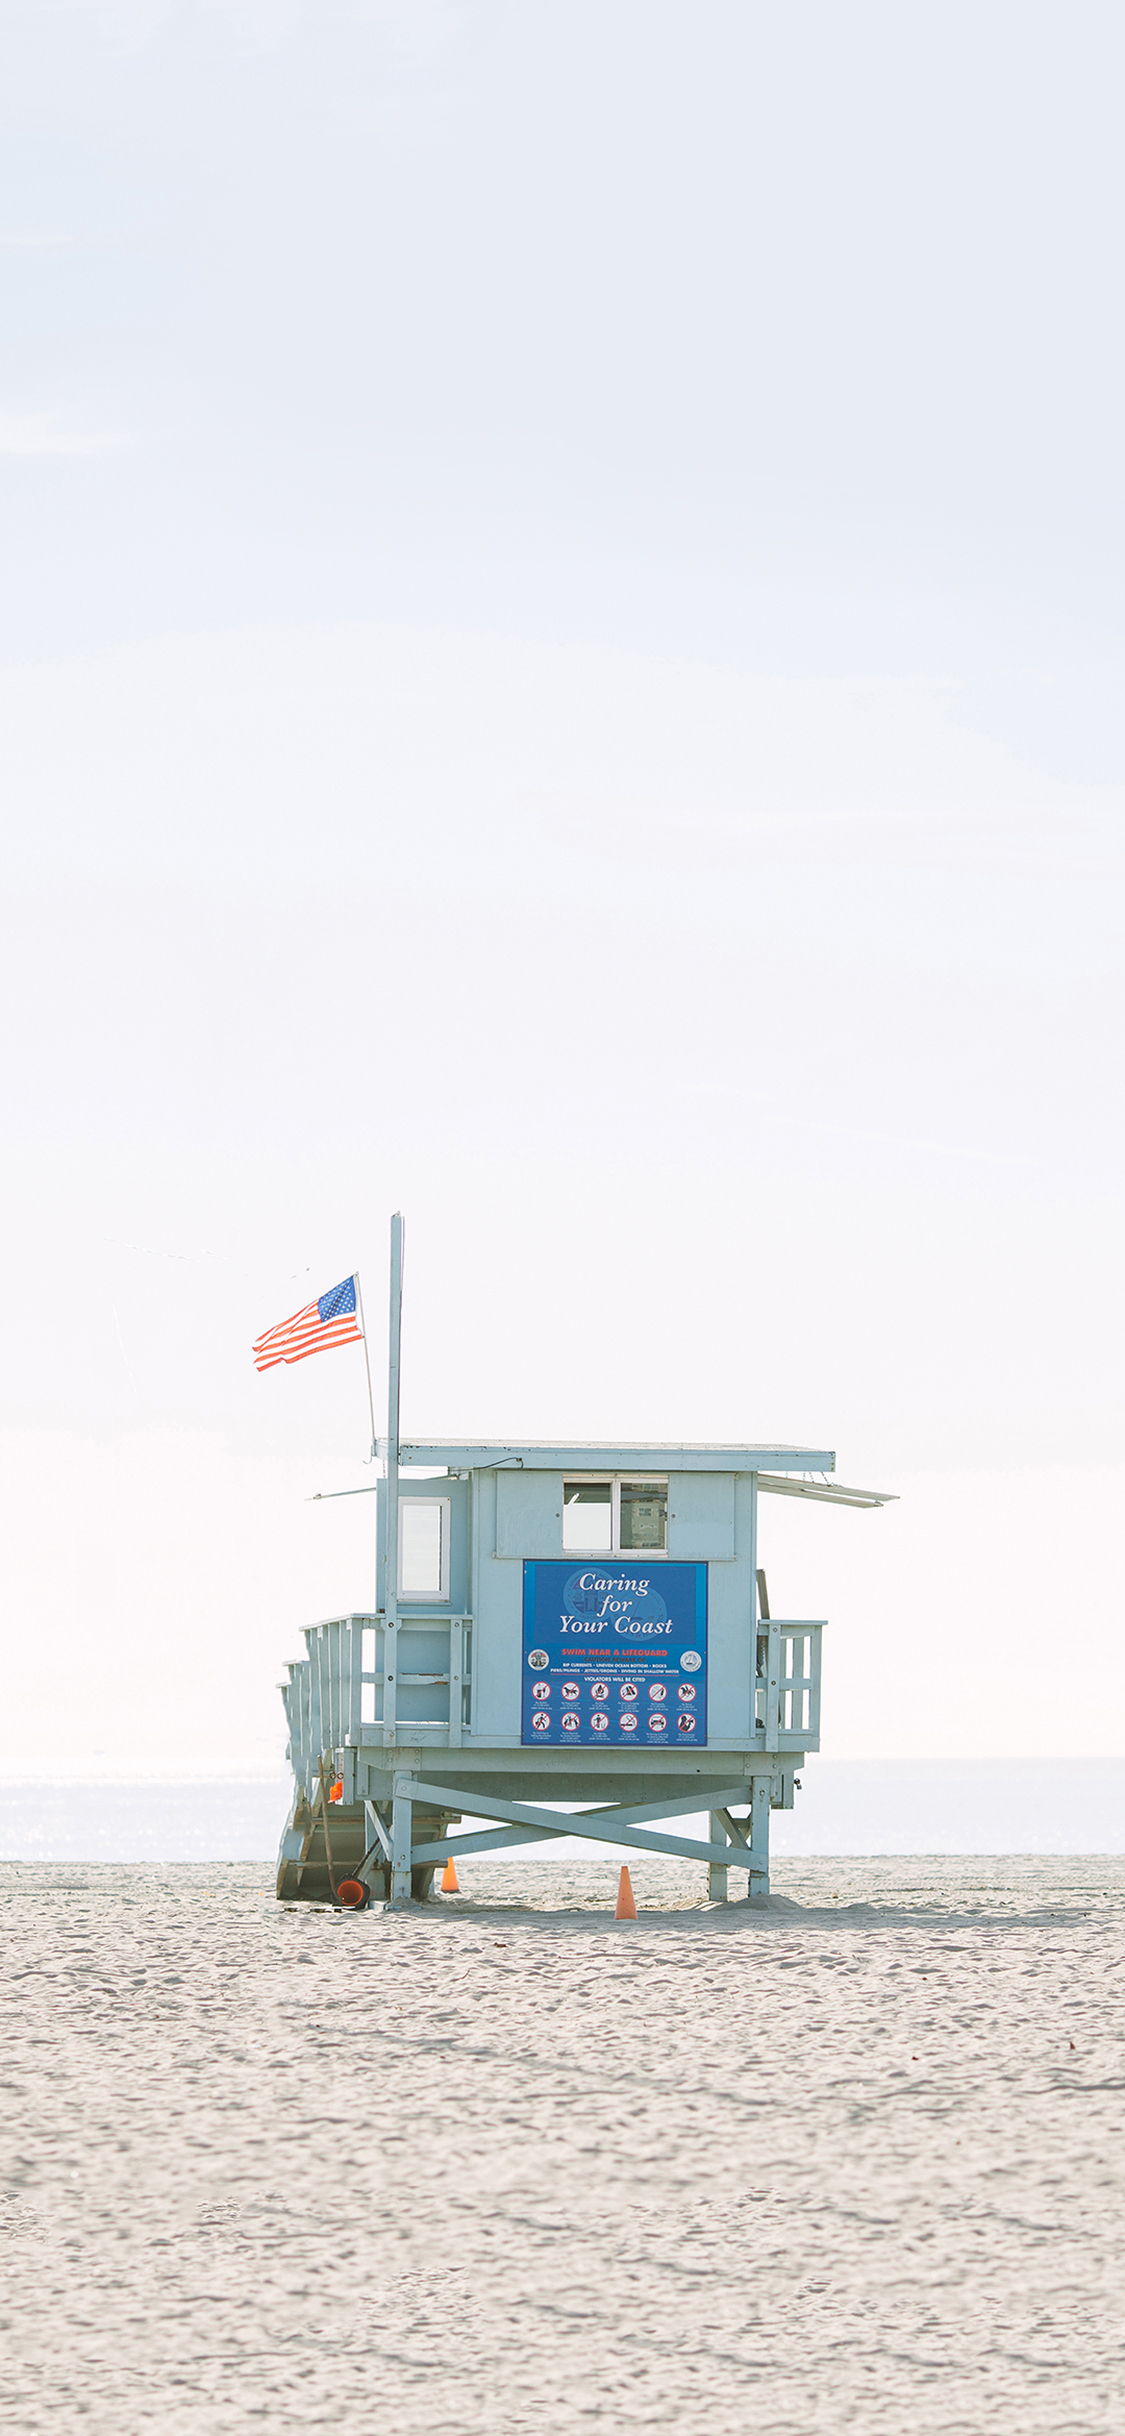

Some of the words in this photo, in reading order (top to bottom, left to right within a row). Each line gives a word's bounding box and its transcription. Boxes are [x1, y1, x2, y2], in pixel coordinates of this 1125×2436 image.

[579, 1573, 650, 1597] Caring
[596, 1595, 633, 1617] for
[559, 1615, 608, 1633] Your
[614, 1616, 673, 1634] Coast
